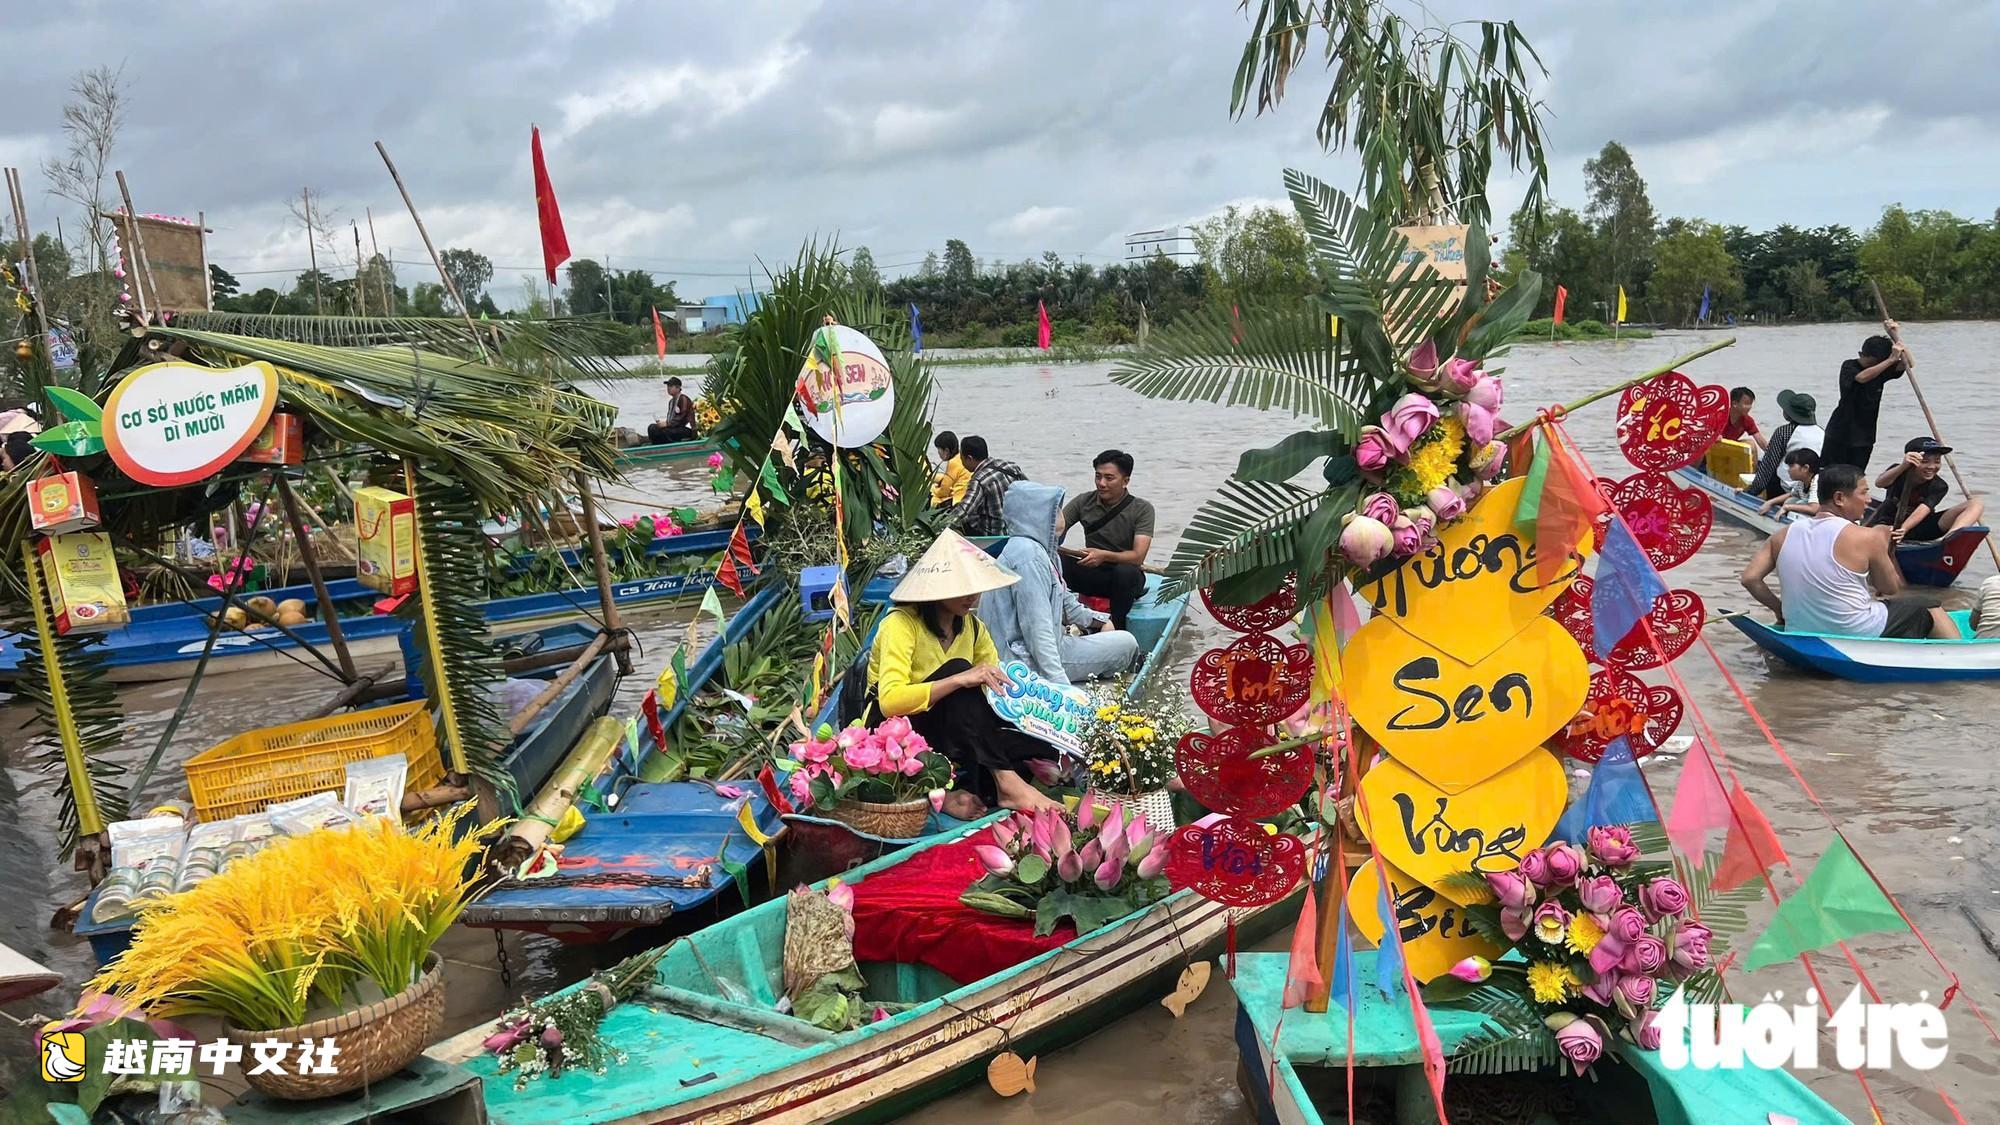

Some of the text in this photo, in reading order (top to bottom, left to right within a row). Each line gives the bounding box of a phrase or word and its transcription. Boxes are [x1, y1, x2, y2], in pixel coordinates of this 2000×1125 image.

[845, 363, 866, 384] SEN
[121, 381, 260, 430] CƠ SỞ NƯỚC MẮM
[164, 411, 226, 442] DÌ MƯỜI
[619, 586, 640, 596] CS
[1005, 662, 1064, 712] Sóng
[1386, 656, 1533, 730] Sen
